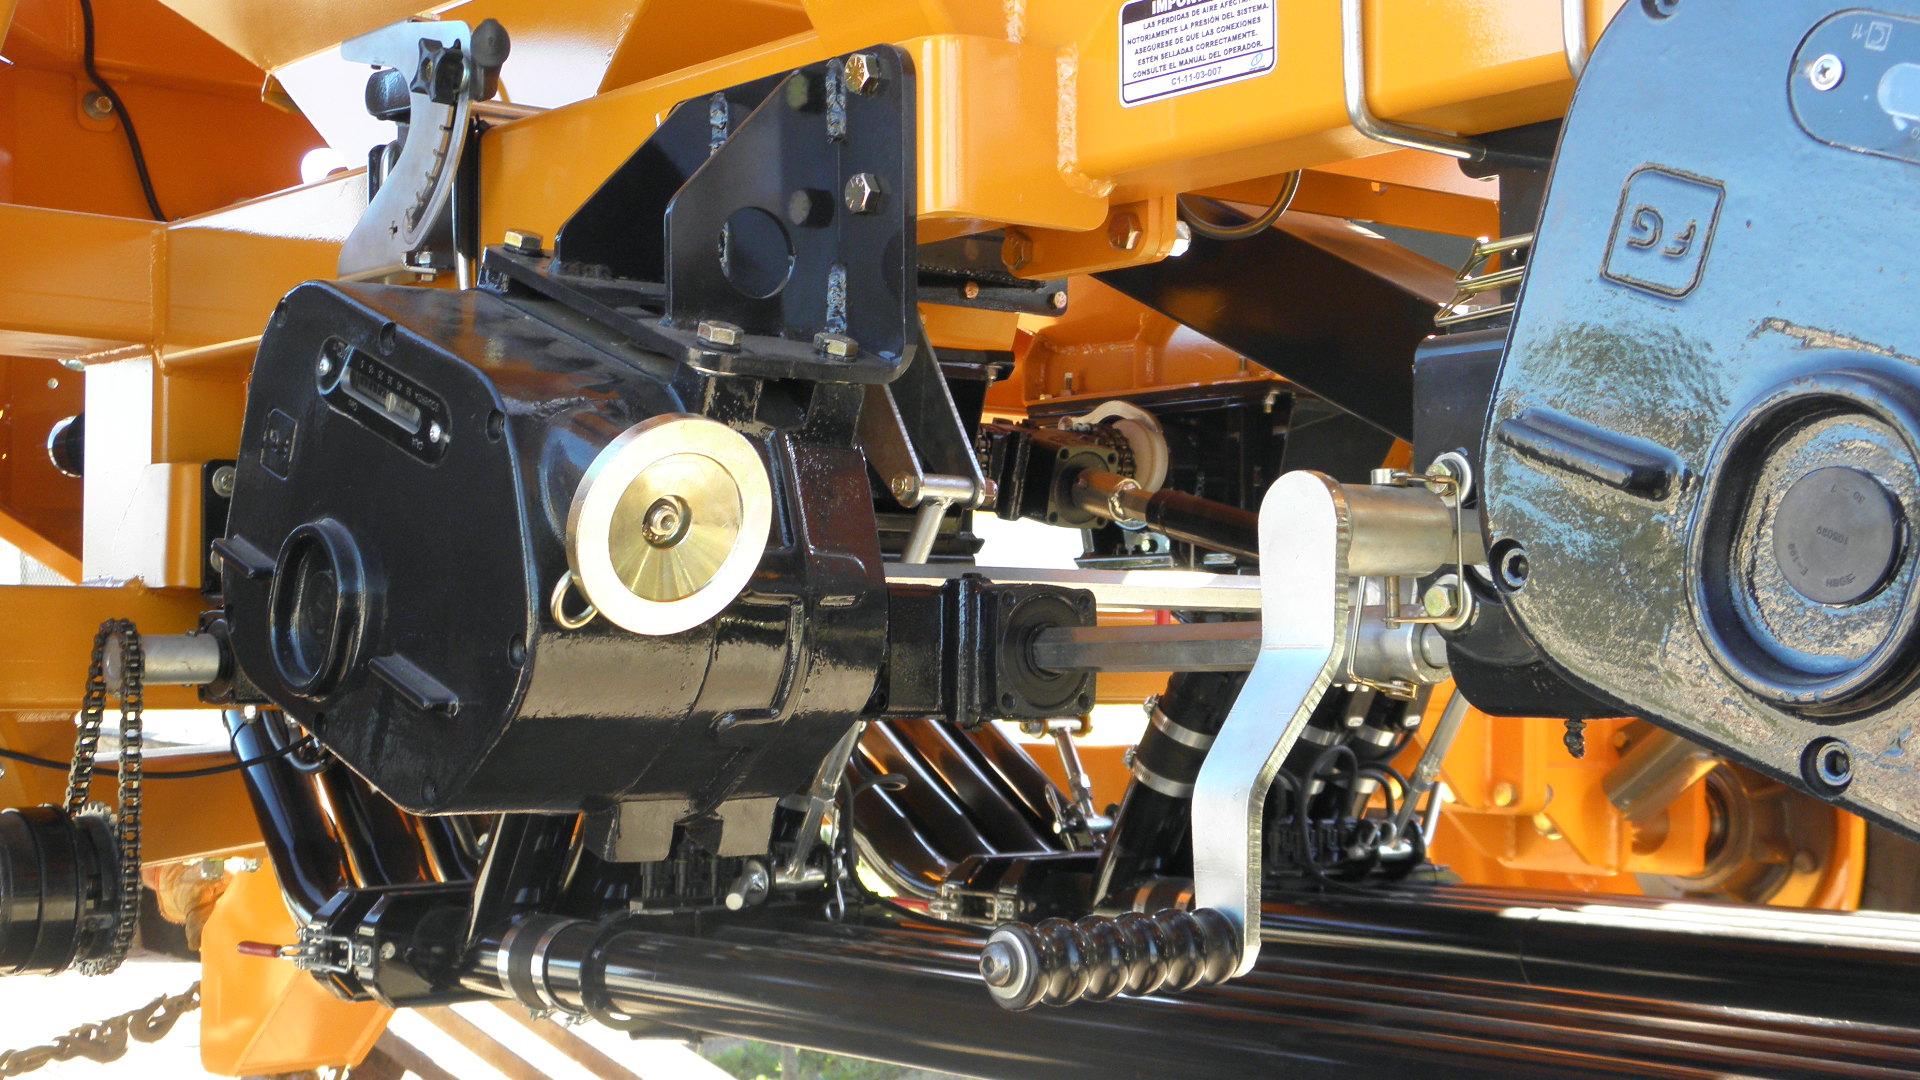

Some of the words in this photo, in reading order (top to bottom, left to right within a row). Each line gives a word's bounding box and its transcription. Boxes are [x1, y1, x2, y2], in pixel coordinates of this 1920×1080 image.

[1127, 27, 1178, 45] NOTORIAMENTE
[1222, 12, 1234, 20] DEL
[1143, 21, 1155, 30] LAS
[1202, 4, 1218, 14] AIRE
[1175, 36, 1183, 44] DE
[1186, 32, 1199, 42] QUE
[1201, 28, 1214, 37] LAS
[1216, 16, 1261, 33] CONEXIONES
[1132, 62, 1167, 79] CONSULTE
[1179, 54, 1206, 67] MANUAL
[1208, 51, 1221, 59] DEL
[1161, 45, 1193, 59] SELLADAS
[1171, 66, 1222, 86] C1-11-03-007
